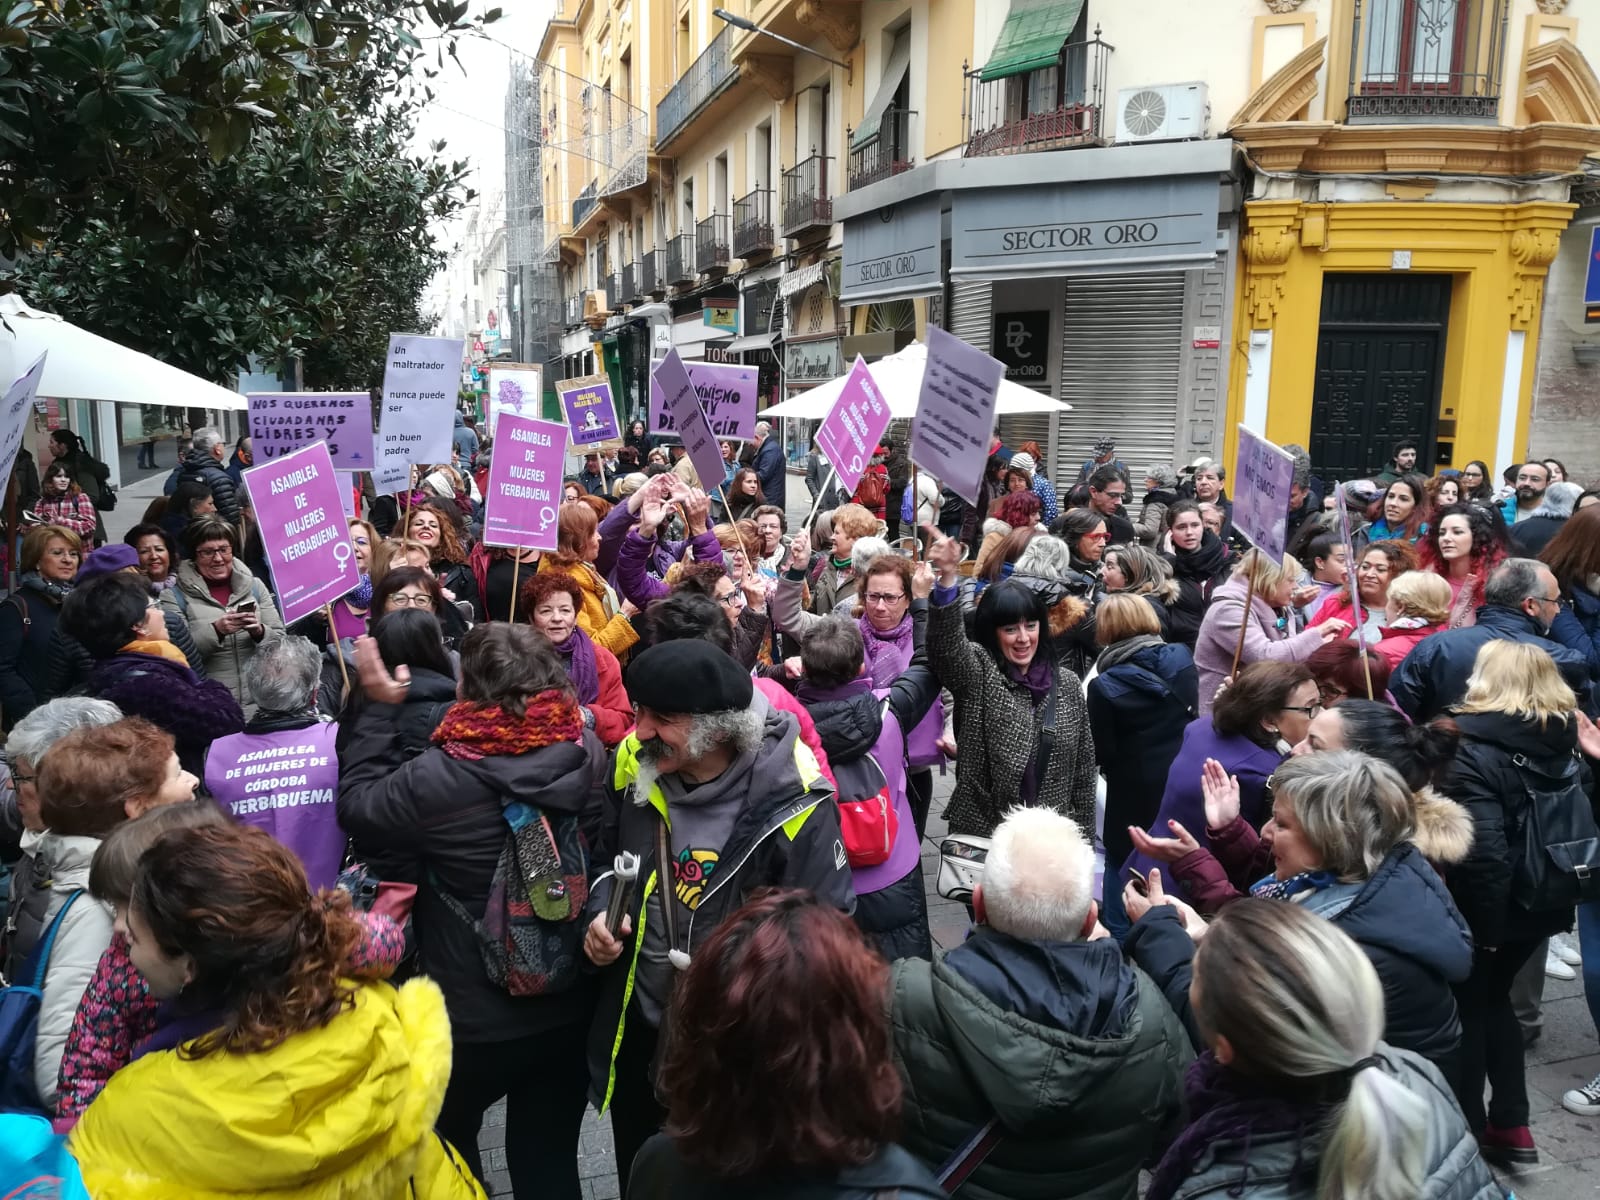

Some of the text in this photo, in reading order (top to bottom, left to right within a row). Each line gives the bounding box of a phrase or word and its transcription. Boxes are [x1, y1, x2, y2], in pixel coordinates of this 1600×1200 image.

[1002, 222, 1158, 251] SECTOR ORO
[860, 255, 916, 281] SECTOR ORO
[394, 346, 406, 354] Un
[392, 360, 445, 370] maltratador
[389, 390, 445, 400] nunca puede
[252, 400, 354, 410] NOS QUEREMOS
[388, 404, 403, 412] ser
[253, 415, 346, 425] CIUDADANAS
[325, 427, 337, 439] Y
[385, 434, 397, 442] un
[510, 428, 552, 447] ASAMBLEA
[384, 446, 410, 456] padre
[525, 449, 535, 462] DE
[271, 464, 319, 495] ASAMBLEA
[509, 465, 545, 482] MUJERES
[294, 492, 308, 510] DE
[500, 482, 550, 502] YERBABUENA
[285, 507, 325, 538] MUJERES
[281, 524, 339, 562] YERBABUENA
[237, 745, 316, 763] ASAMBLEA
[225, 757, 328, 779] DE MUJERES DE
[245, 774, 307, 793] CÓRDOBA
[230, 788, 333, 816] YERBABUENA
